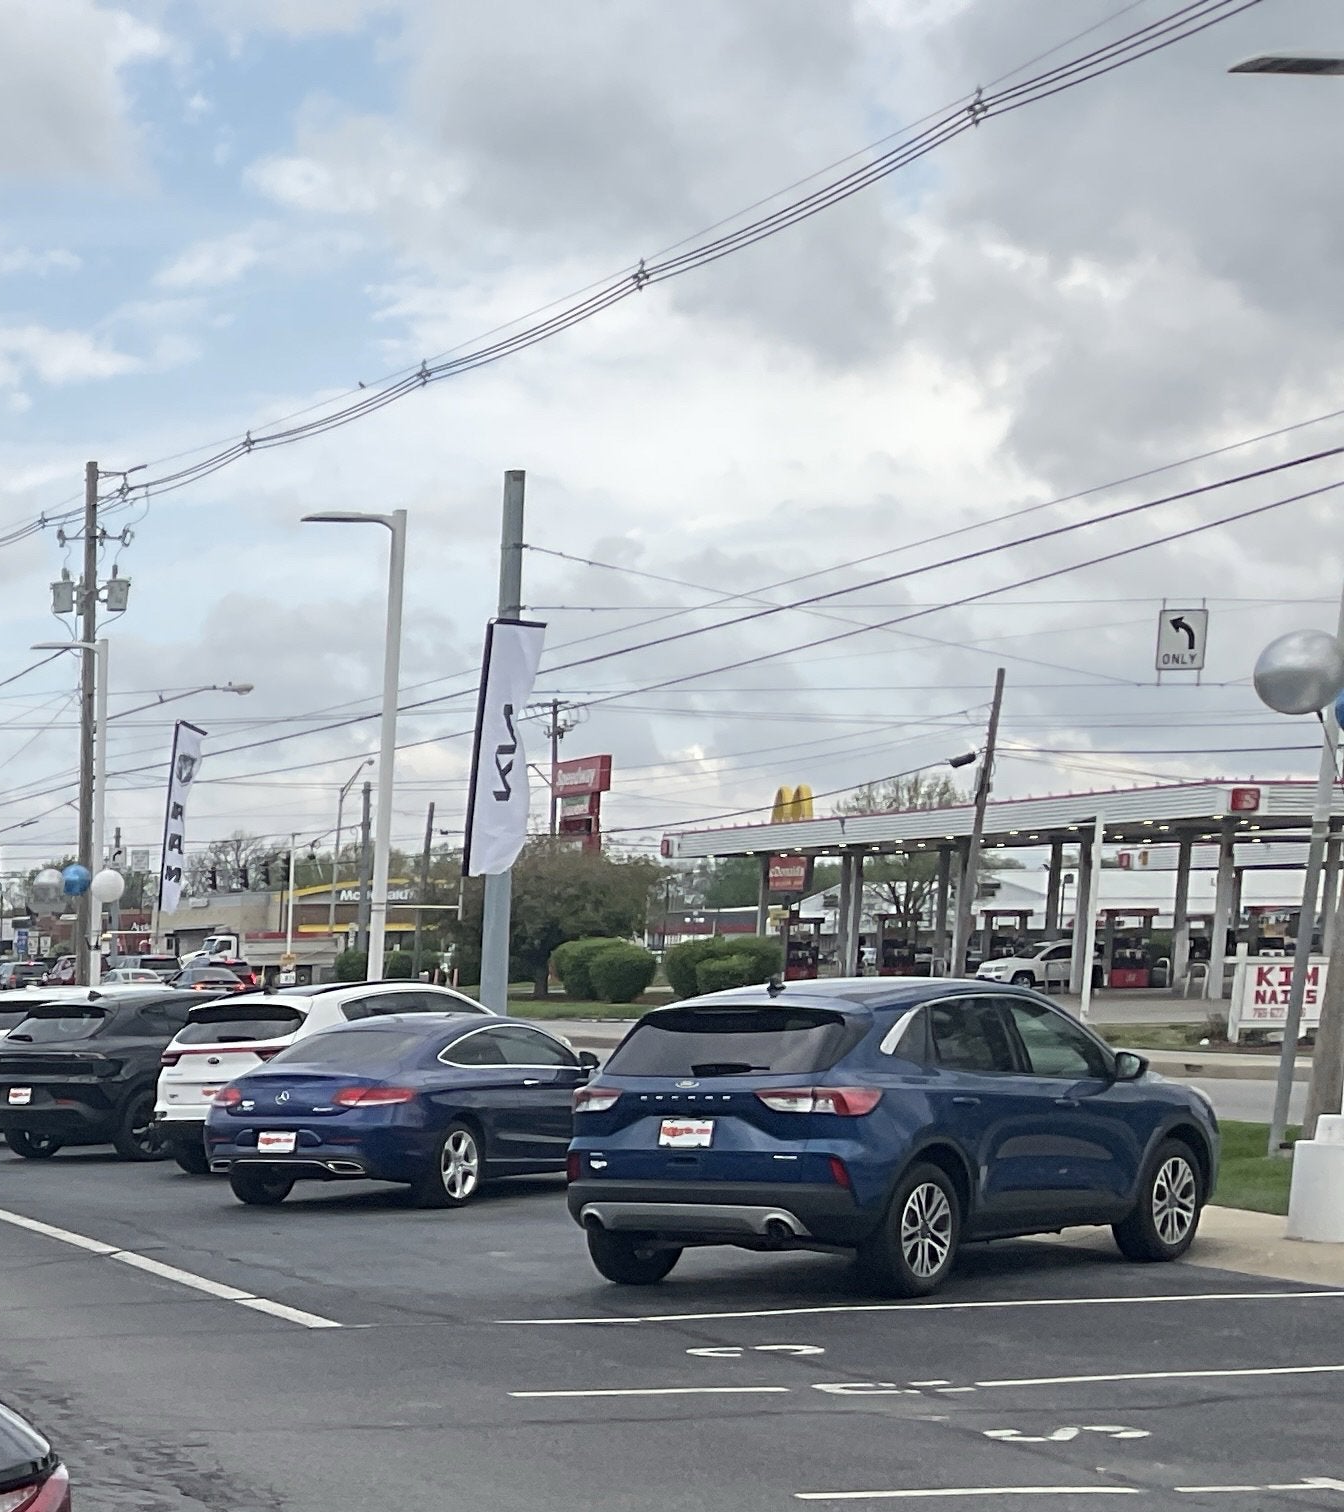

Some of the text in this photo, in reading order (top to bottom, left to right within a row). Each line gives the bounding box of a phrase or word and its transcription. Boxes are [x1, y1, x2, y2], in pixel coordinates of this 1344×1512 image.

[1162, 653, 1198, 665] ONLY
[164, 801, 185, 883] RAM
[1256, 967, 1319, 986] KIM
[1254, 990, 1317, 1005] NAIS
